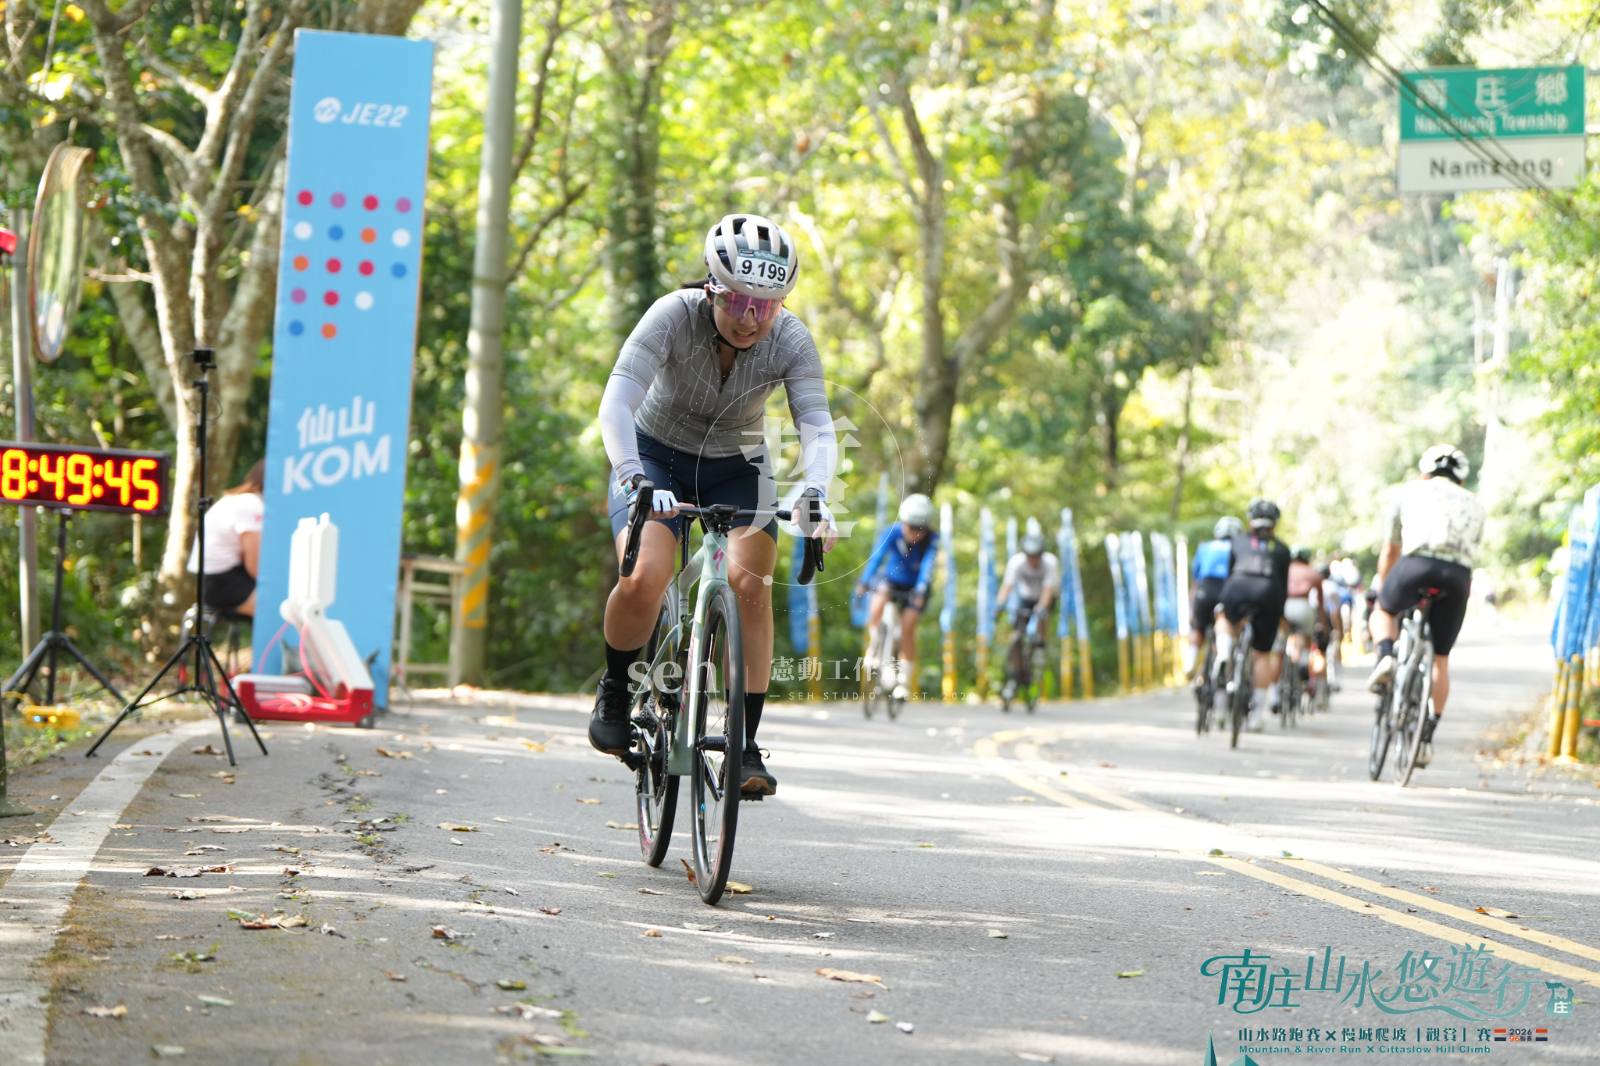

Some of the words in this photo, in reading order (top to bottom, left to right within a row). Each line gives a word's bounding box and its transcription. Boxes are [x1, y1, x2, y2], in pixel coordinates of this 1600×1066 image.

[341, 102, 408, 127] JE22
[1502, 110, 1568, 133] Township
[741, 260, 786, 282] 9199
[297, 395, 375, 450] 仙山
[282, 434, 392, 494] KOM
